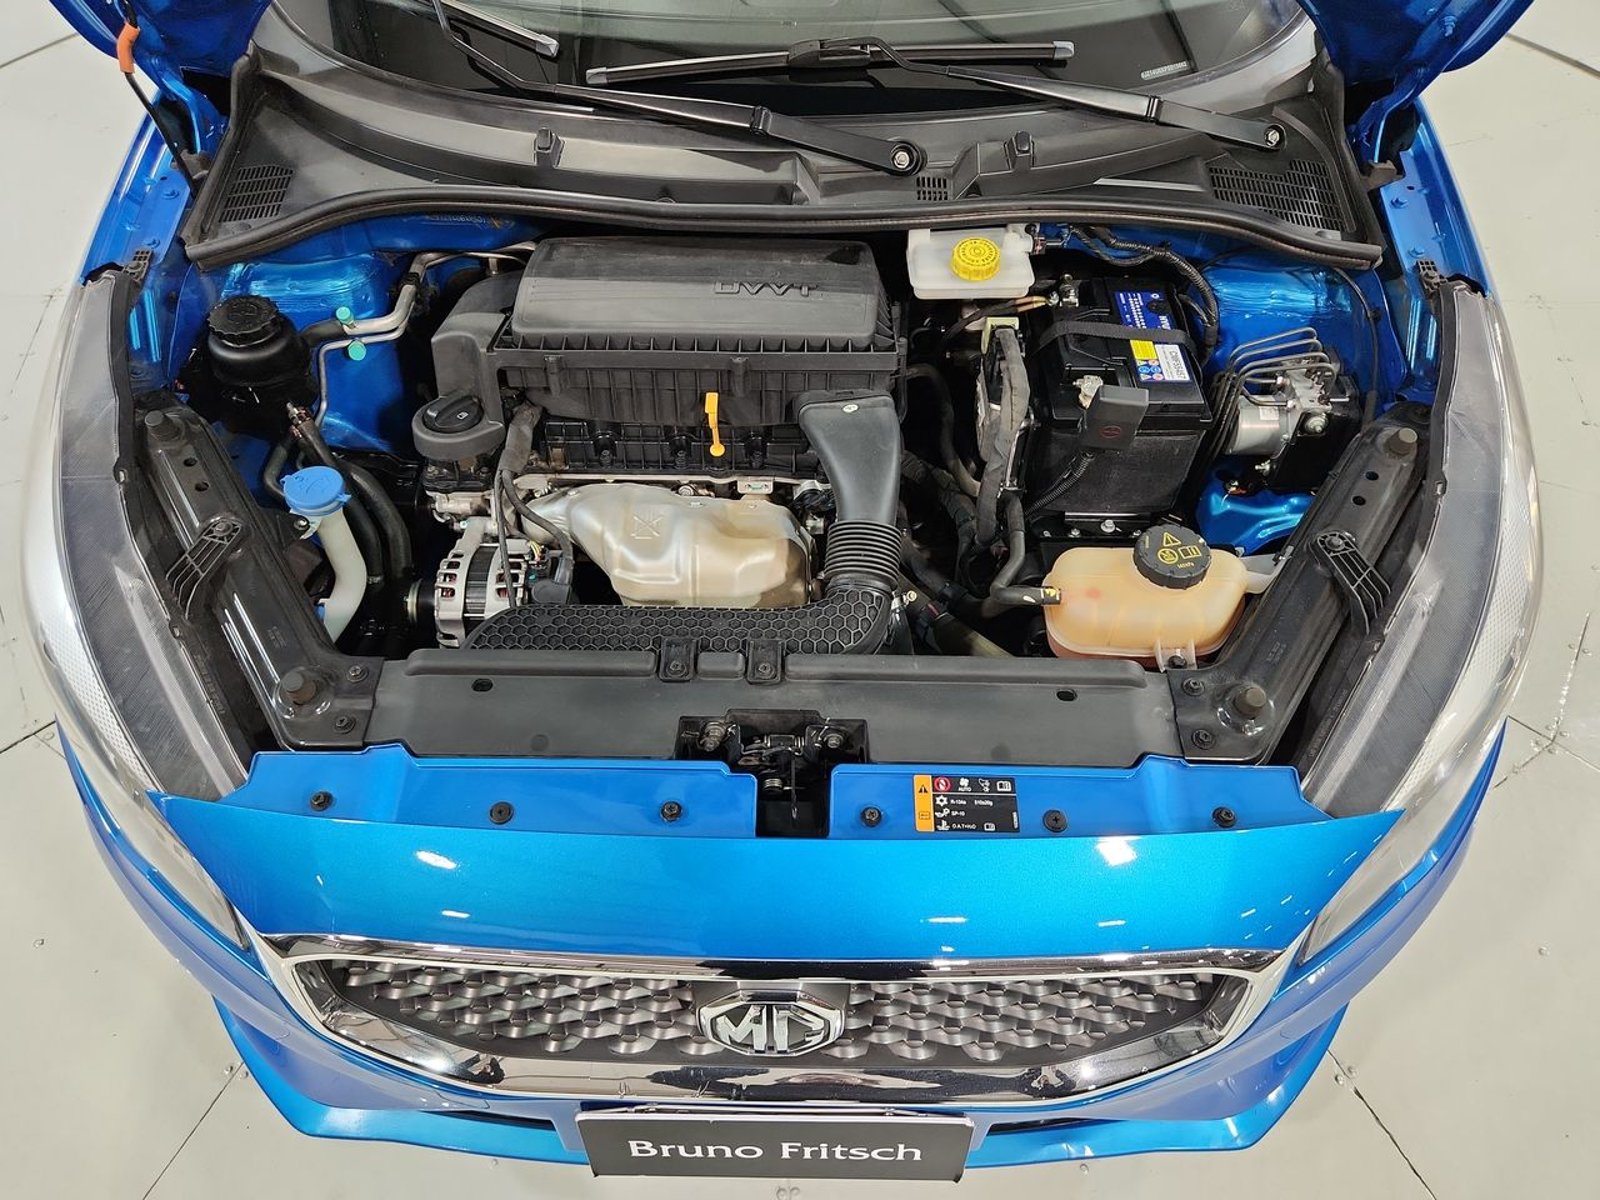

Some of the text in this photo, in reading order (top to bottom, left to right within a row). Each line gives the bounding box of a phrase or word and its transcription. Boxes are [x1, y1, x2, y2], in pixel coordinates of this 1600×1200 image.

[714, 281, 818, 297] DVVT
[715, 1004, 826, 1052] MG
[627, 1140, 922, 1161] Bruno Fritsch
